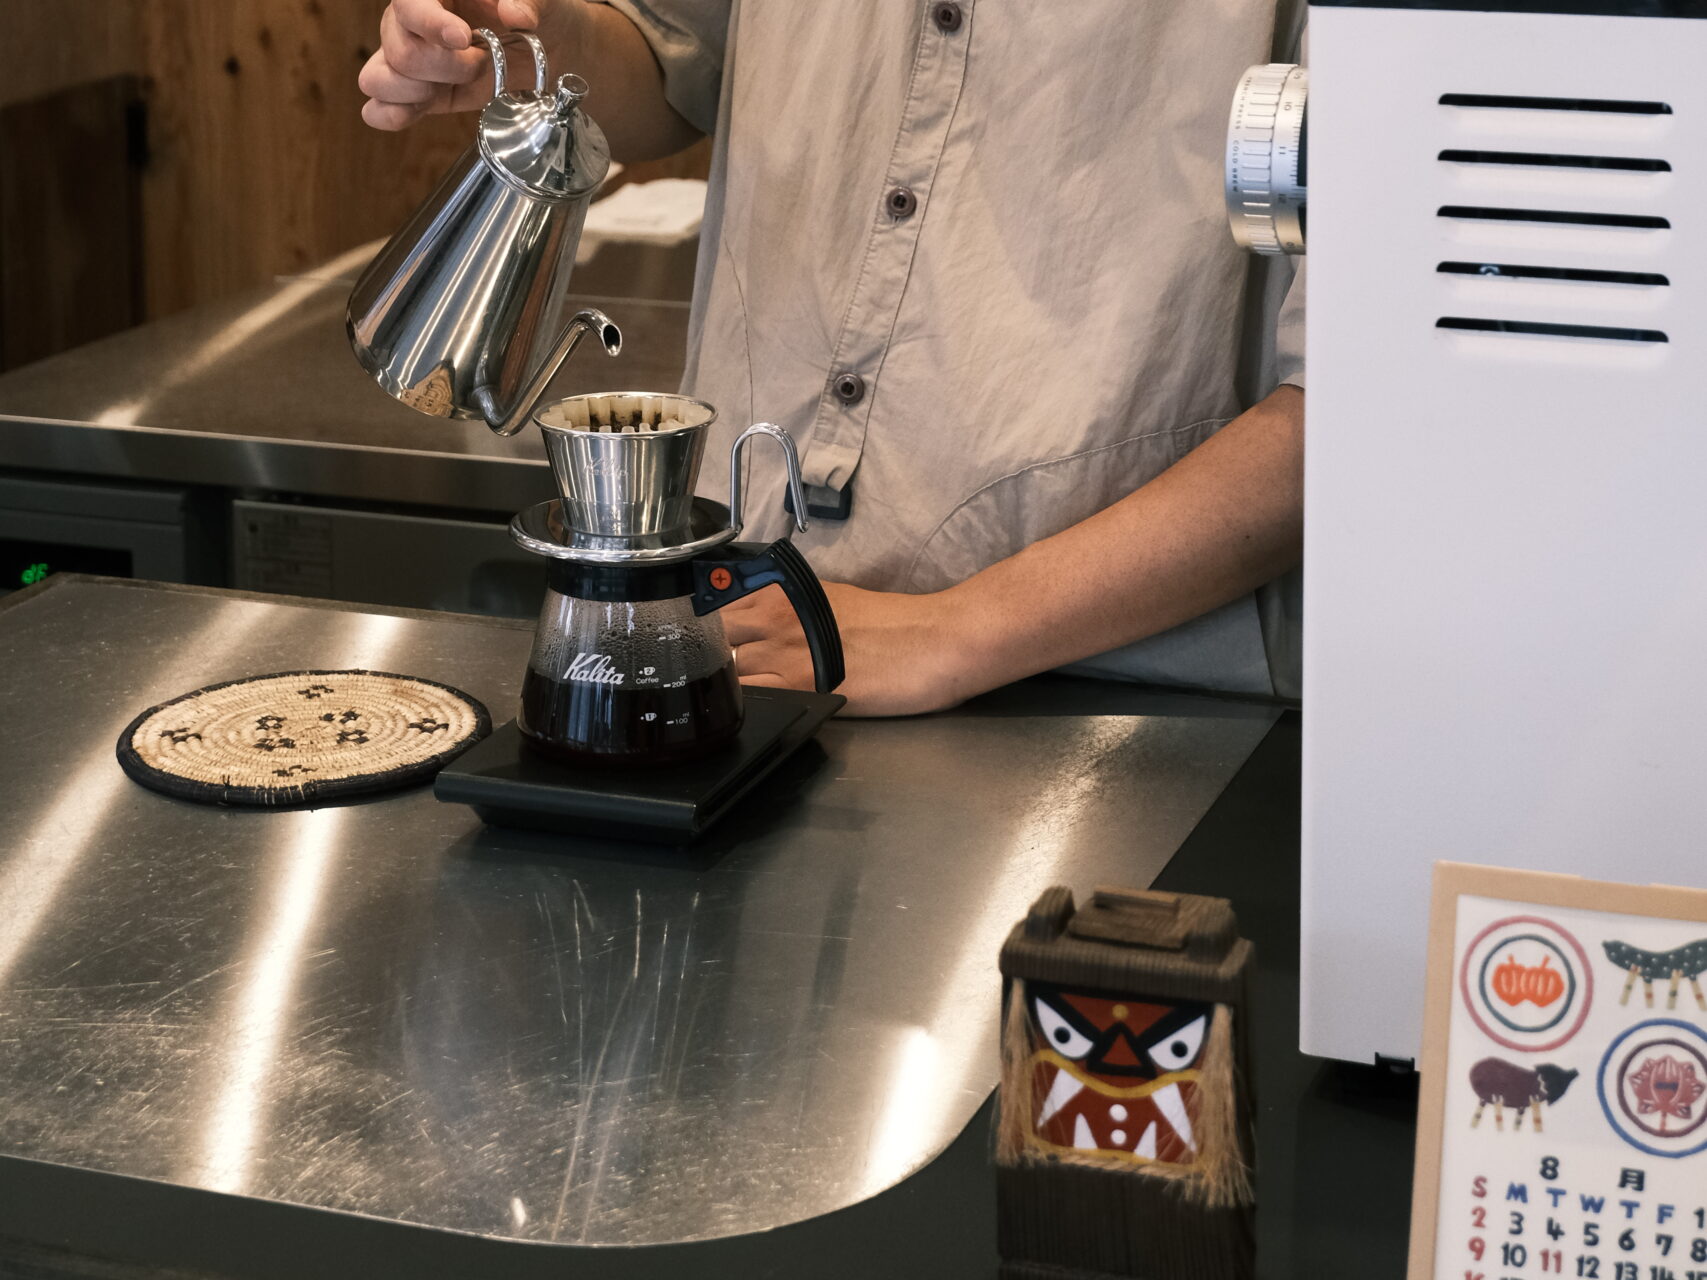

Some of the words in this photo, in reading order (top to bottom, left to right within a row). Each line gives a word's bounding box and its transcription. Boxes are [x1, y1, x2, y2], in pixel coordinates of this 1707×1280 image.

[562, 652, 625, 685] Kalita
[635, 677, 660, 685] Coffee
[1539, 1156, 1560, 1180] 8
[1618, 1167, 1645, 1192] 月
[1472, 1175, 1487, 1198] S
[1505, 1181, 1529, 1204] M
[1545, 1187, 1567, 1207] T
[1579, 1194, 1605, 1214] W
[1619, 1200, 1640, 1219] T
[1657, 1204, 1675, 1224] F
[1694, 1207, 1705, 1229] 1
[1471, 1206, 1487, 1228] 2
[1508, 1211, 1524, 1235] 3
[1546, 1217, 1566, 1241] 4
[1583, 1222, 1600, 1247] 5
[1618, 1228, 1636, 1251] 6
[1655, 1233, 1674, 1257] 7
[1690, 1237, 1707, 1263] 8
[1468, 1236, 1486, 1261] 9
[1501, 1241, 1527, 1268] 10
[1540, 1248, 1562, 1273] 11
[1576, 1255, 1600, 1279] 12
